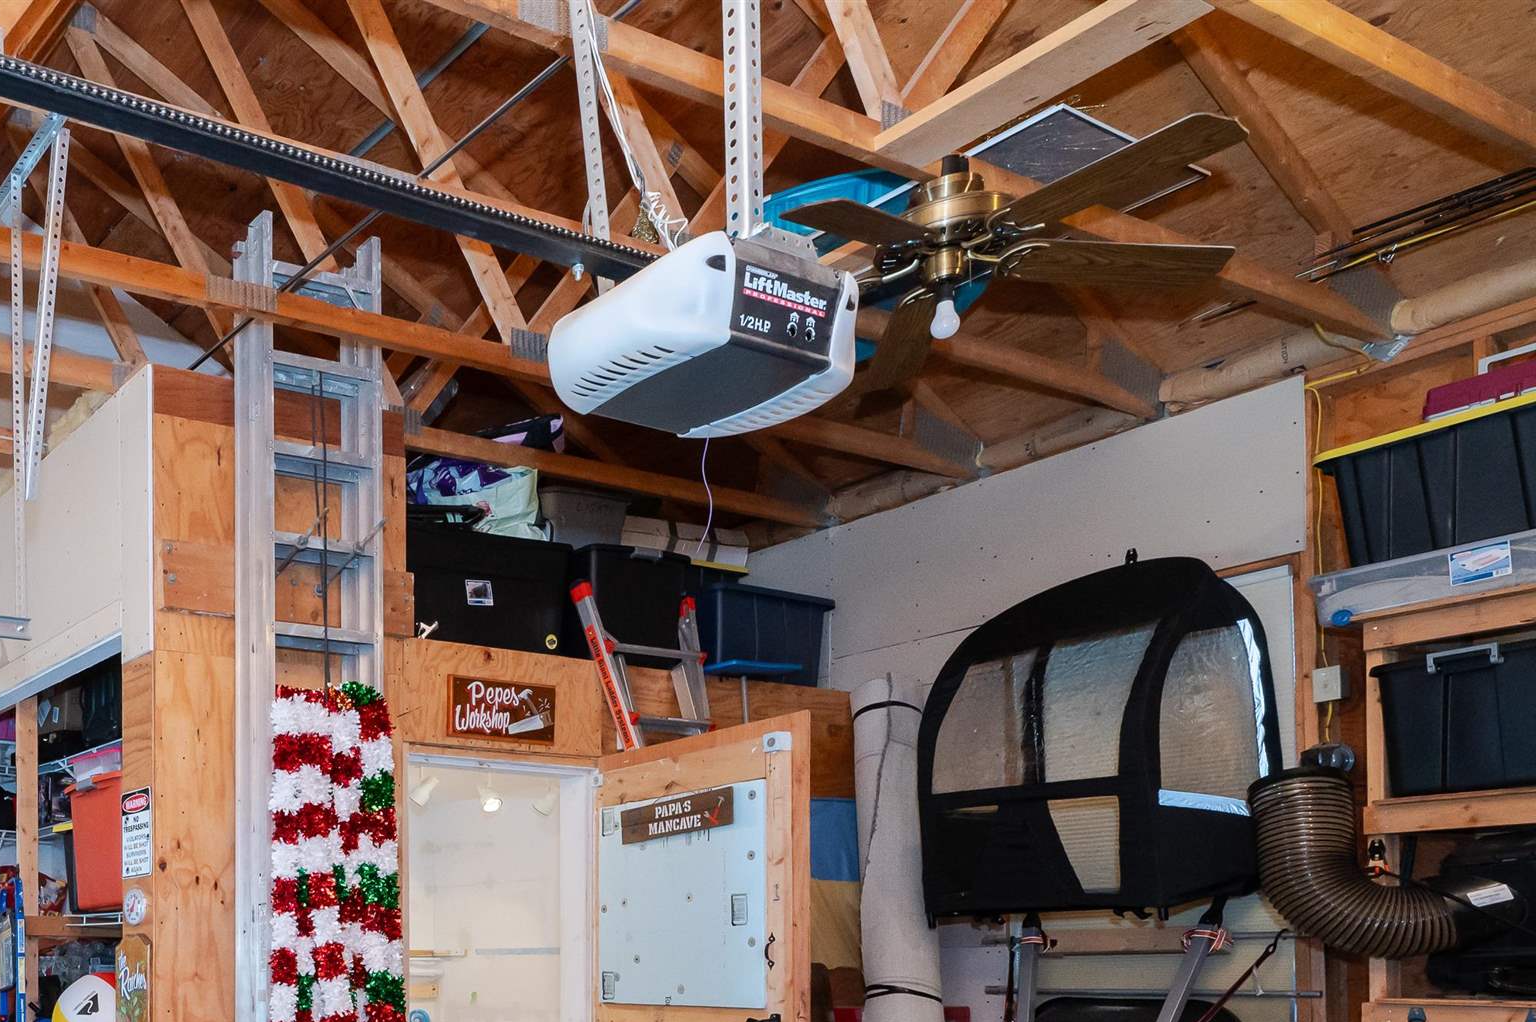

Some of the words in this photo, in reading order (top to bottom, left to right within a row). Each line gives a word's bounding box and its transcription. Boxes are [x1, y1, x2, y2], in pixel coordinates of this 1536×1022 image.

[743, 288, 826, 318] PROFESSIONAL
[466, 681, 520, 710] Pepes
[455, 703, 510, 734] Workshop
[648, 814, 701, 835] MANCAVE
